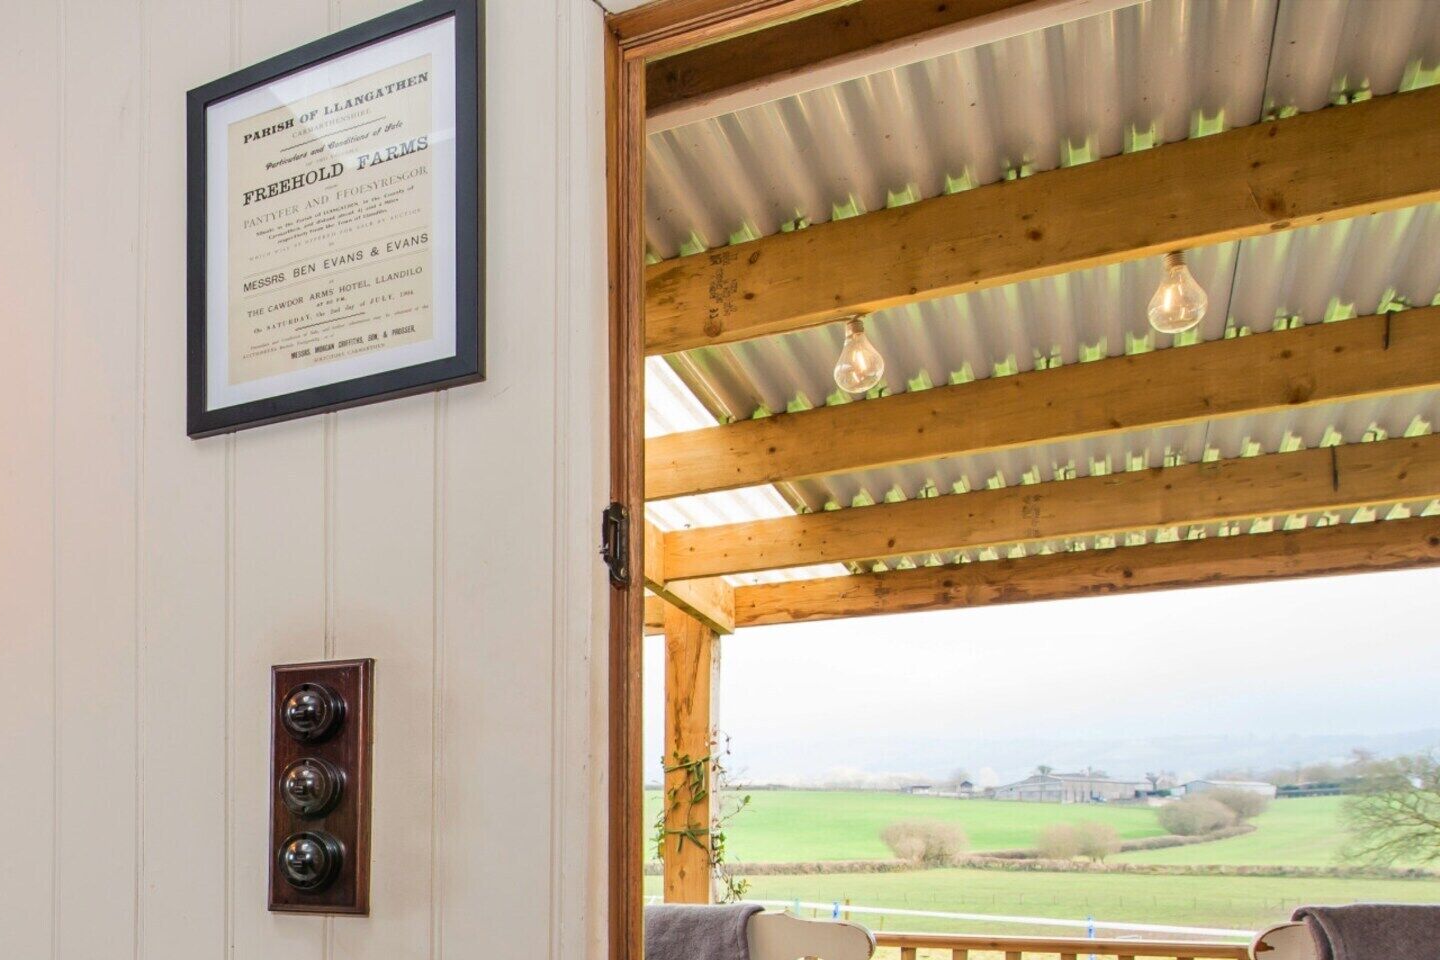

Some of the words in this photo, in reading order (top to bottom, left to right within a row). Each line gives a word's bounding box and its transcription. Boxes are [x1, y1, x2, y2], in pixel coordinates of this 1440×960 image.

[243, 117, 294, 144] PARISH
[300, 108, 317, 124] OF
[325, 71, 427, 115] LLANGATHEN
[243, 160, 343, 206] FREEHOLD
[356, 134, 428, 170] FARMS
[305, 194, 328, 209] AND
[293, 262, 315, 278] BEN
[323, 250, 362, 269] EVANS
[370, 246, 379, 257] &
[386, 232, 428, 253] EVANS
[247, 307, 263, 318] THE
[268, 296, 303, 313] CAWDOR
[309, 288, 333, 301] ARMS
[375, 265, 422, 284] LLANDILO
